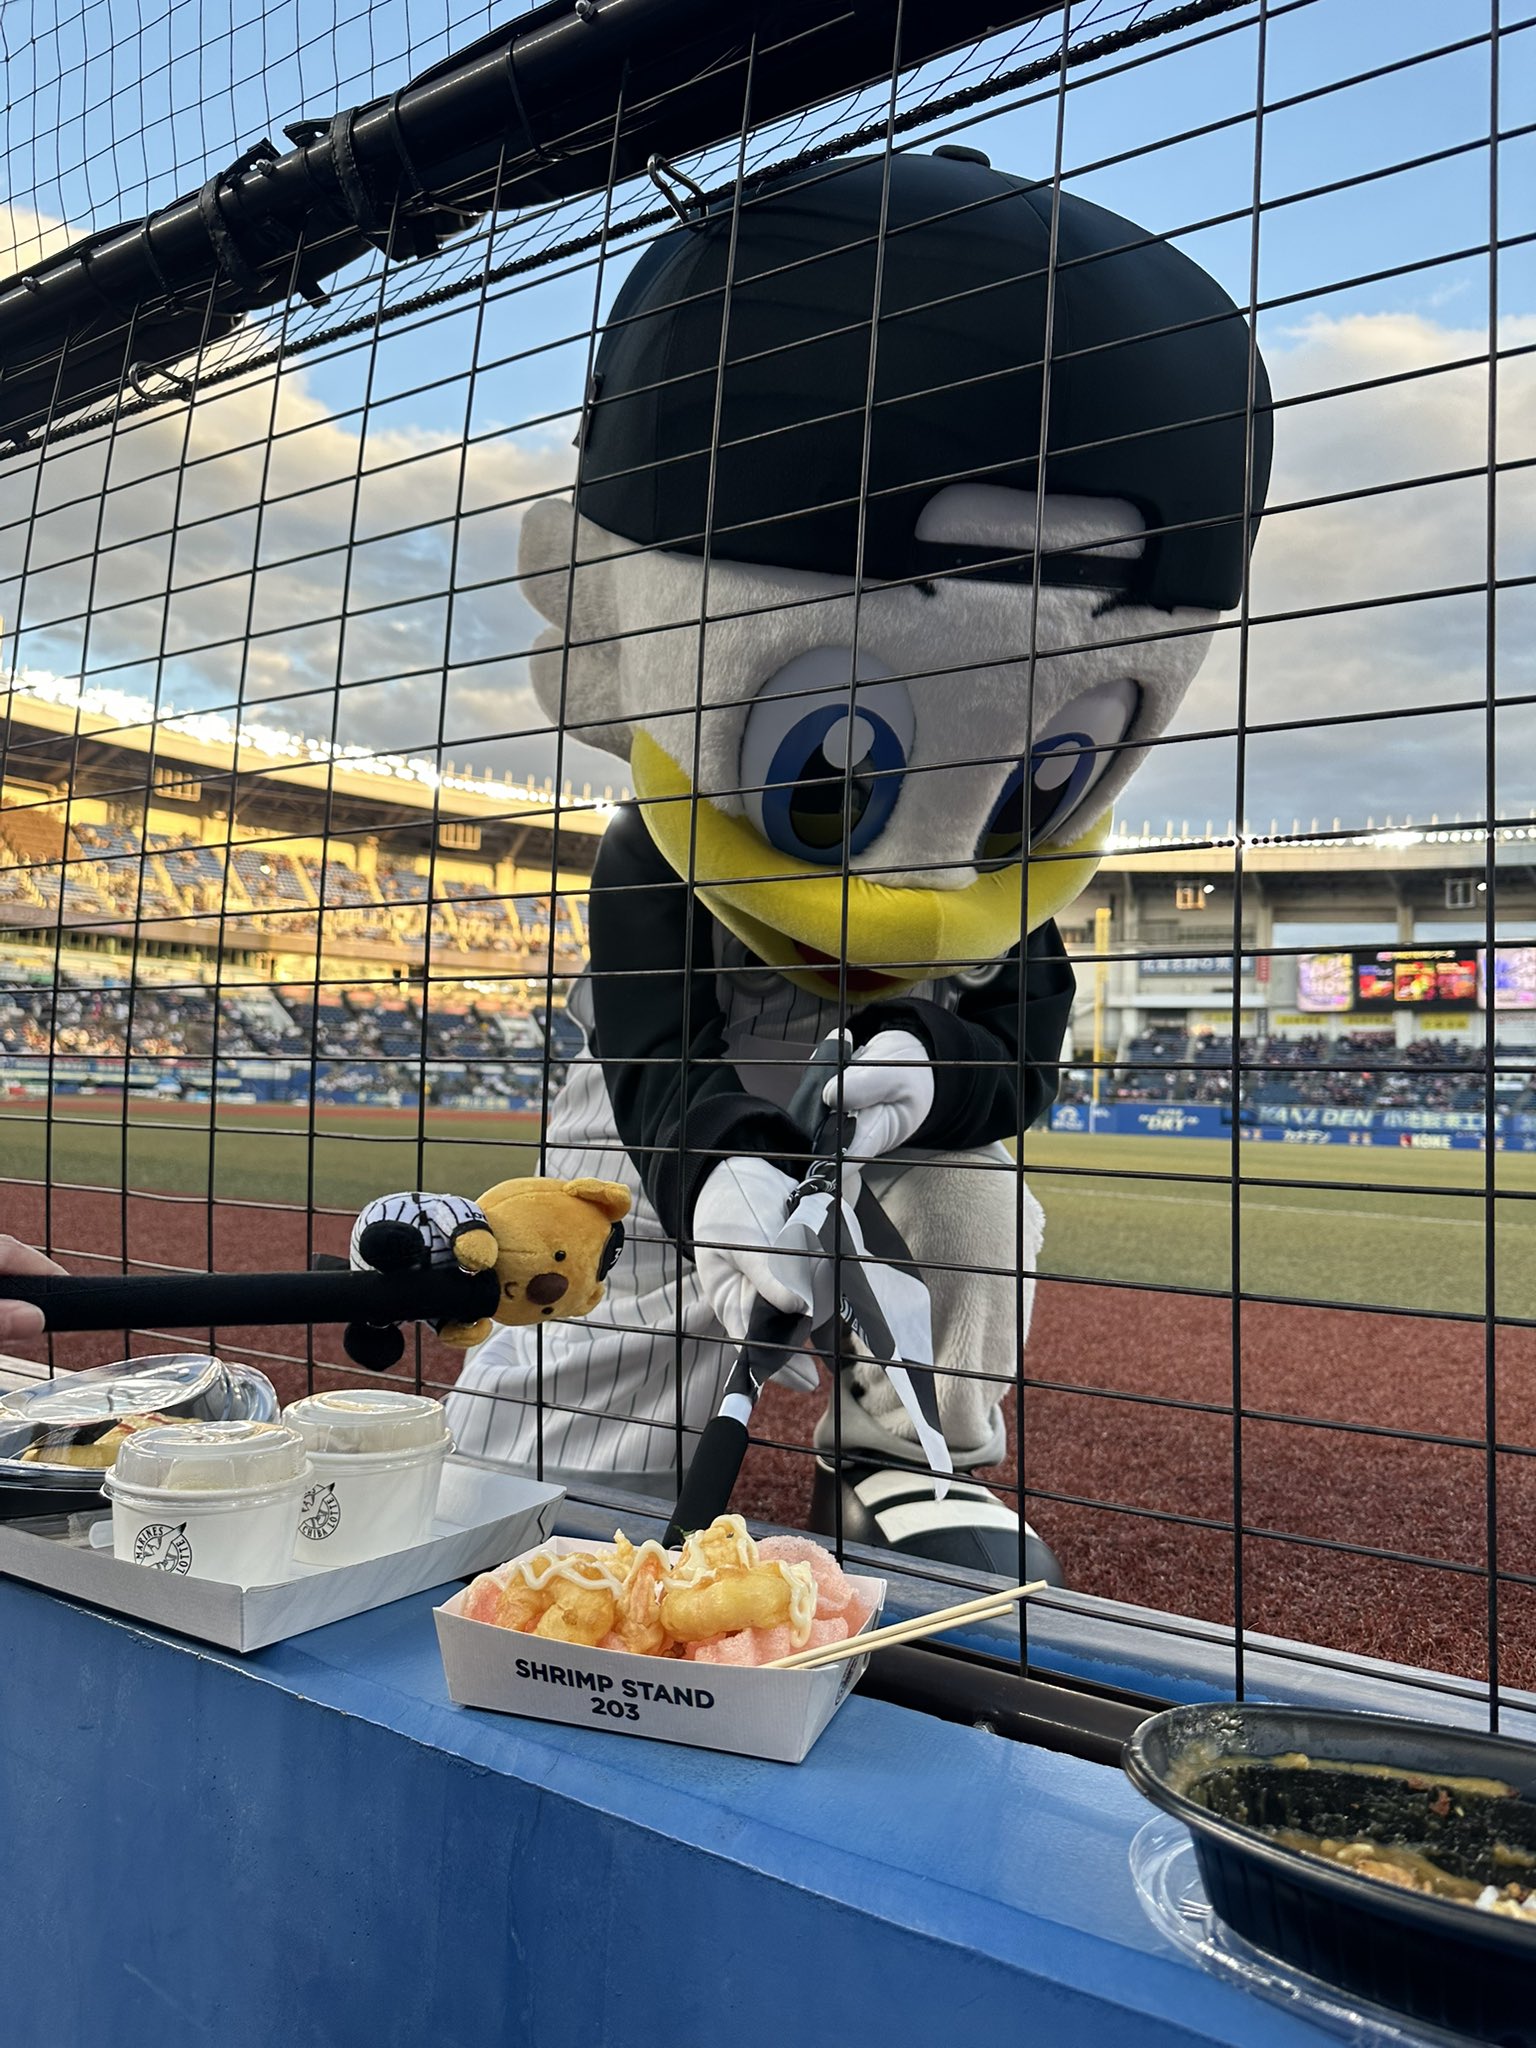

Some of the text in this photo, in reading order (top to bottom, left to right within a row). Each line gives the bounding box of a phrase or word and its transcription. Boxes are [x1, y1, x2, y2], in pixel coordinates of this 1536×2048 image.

[302, 1497, 339, 1538] CHIBA LOTTE
[135, 1526, 164, 1559] MARINES
[175, 1538, 190, 1574] LOTTE
[515, 1658, 715, 1709] SHRIMP STAND
[590, 1697, 640, 1721] 203
